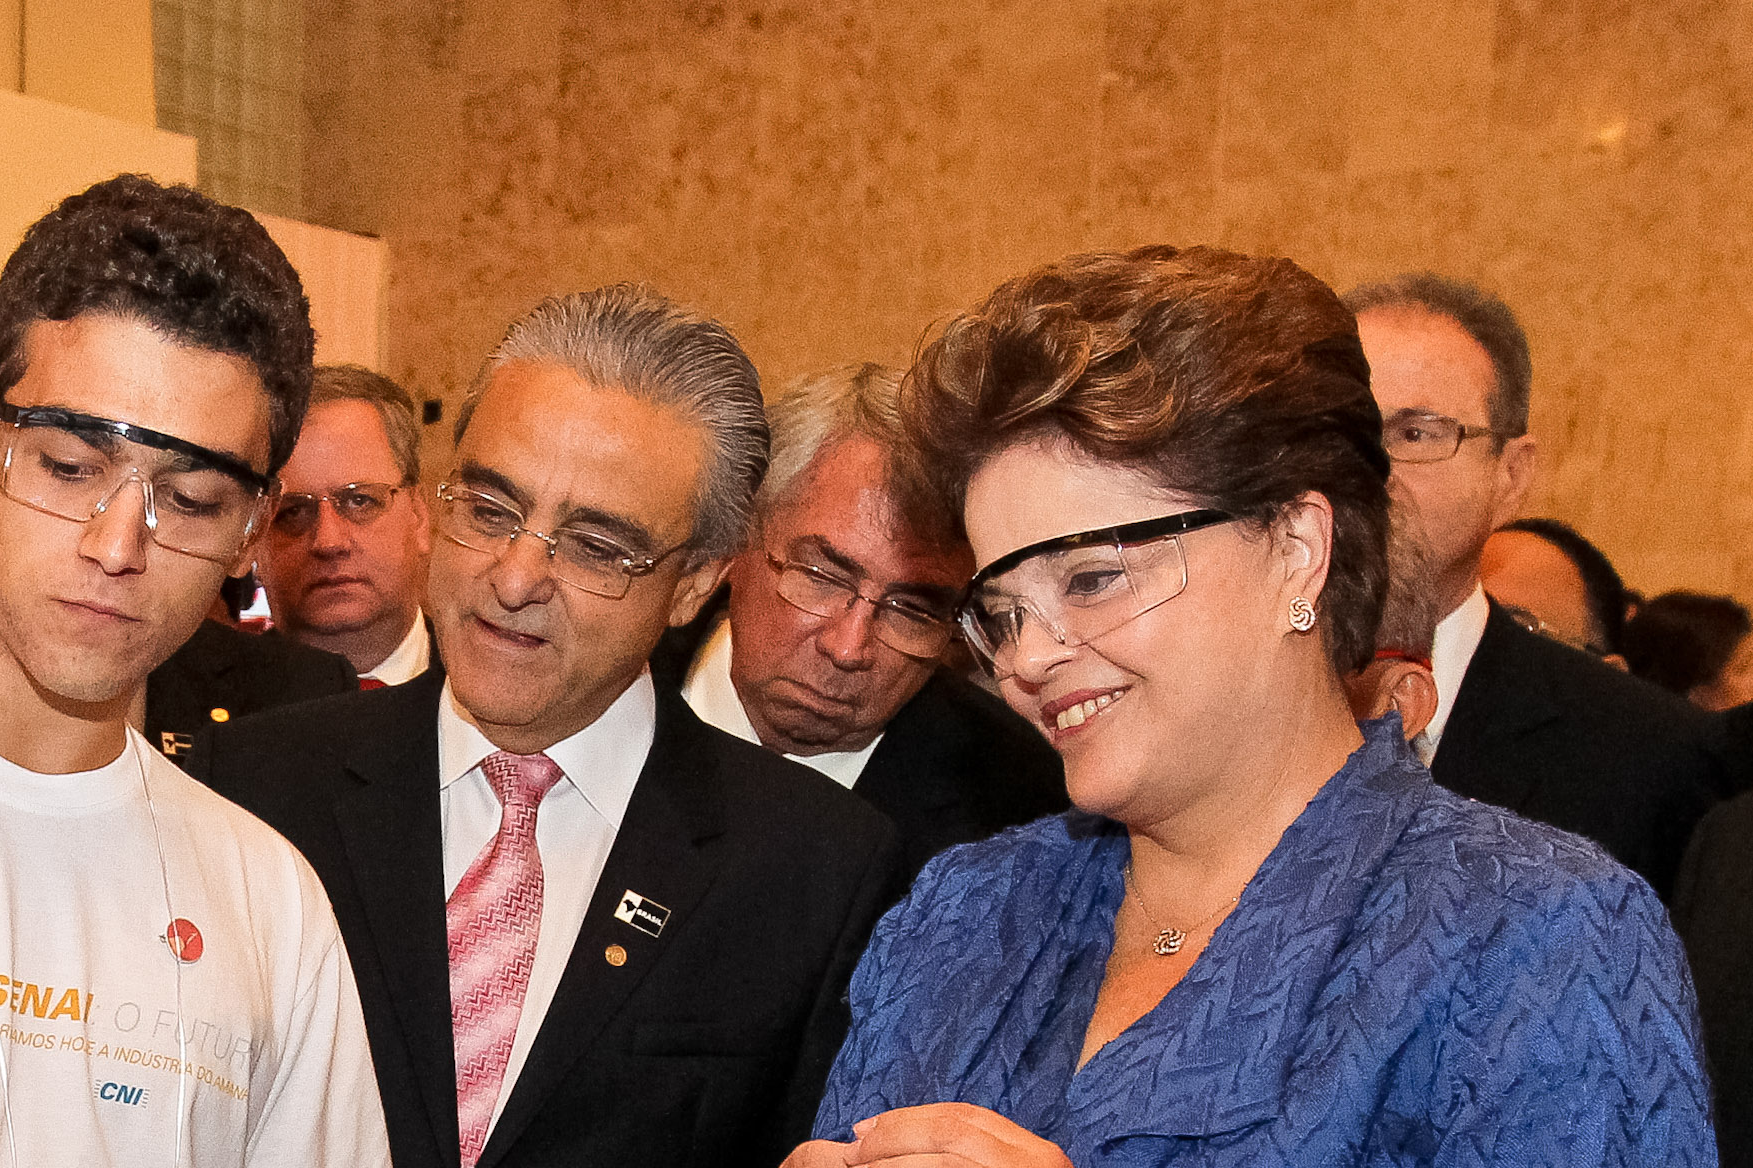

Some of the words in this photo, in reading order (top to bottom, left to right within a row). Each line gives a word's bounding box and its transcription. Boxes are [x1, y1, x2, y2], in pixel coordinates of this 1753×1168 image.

[114, 1001, 141, 1033] O
[151, 1009, 253, 1069] FUTUR
[97, 1043, 109, 1058] A
[100, 1081, 144, 1106] CNI
